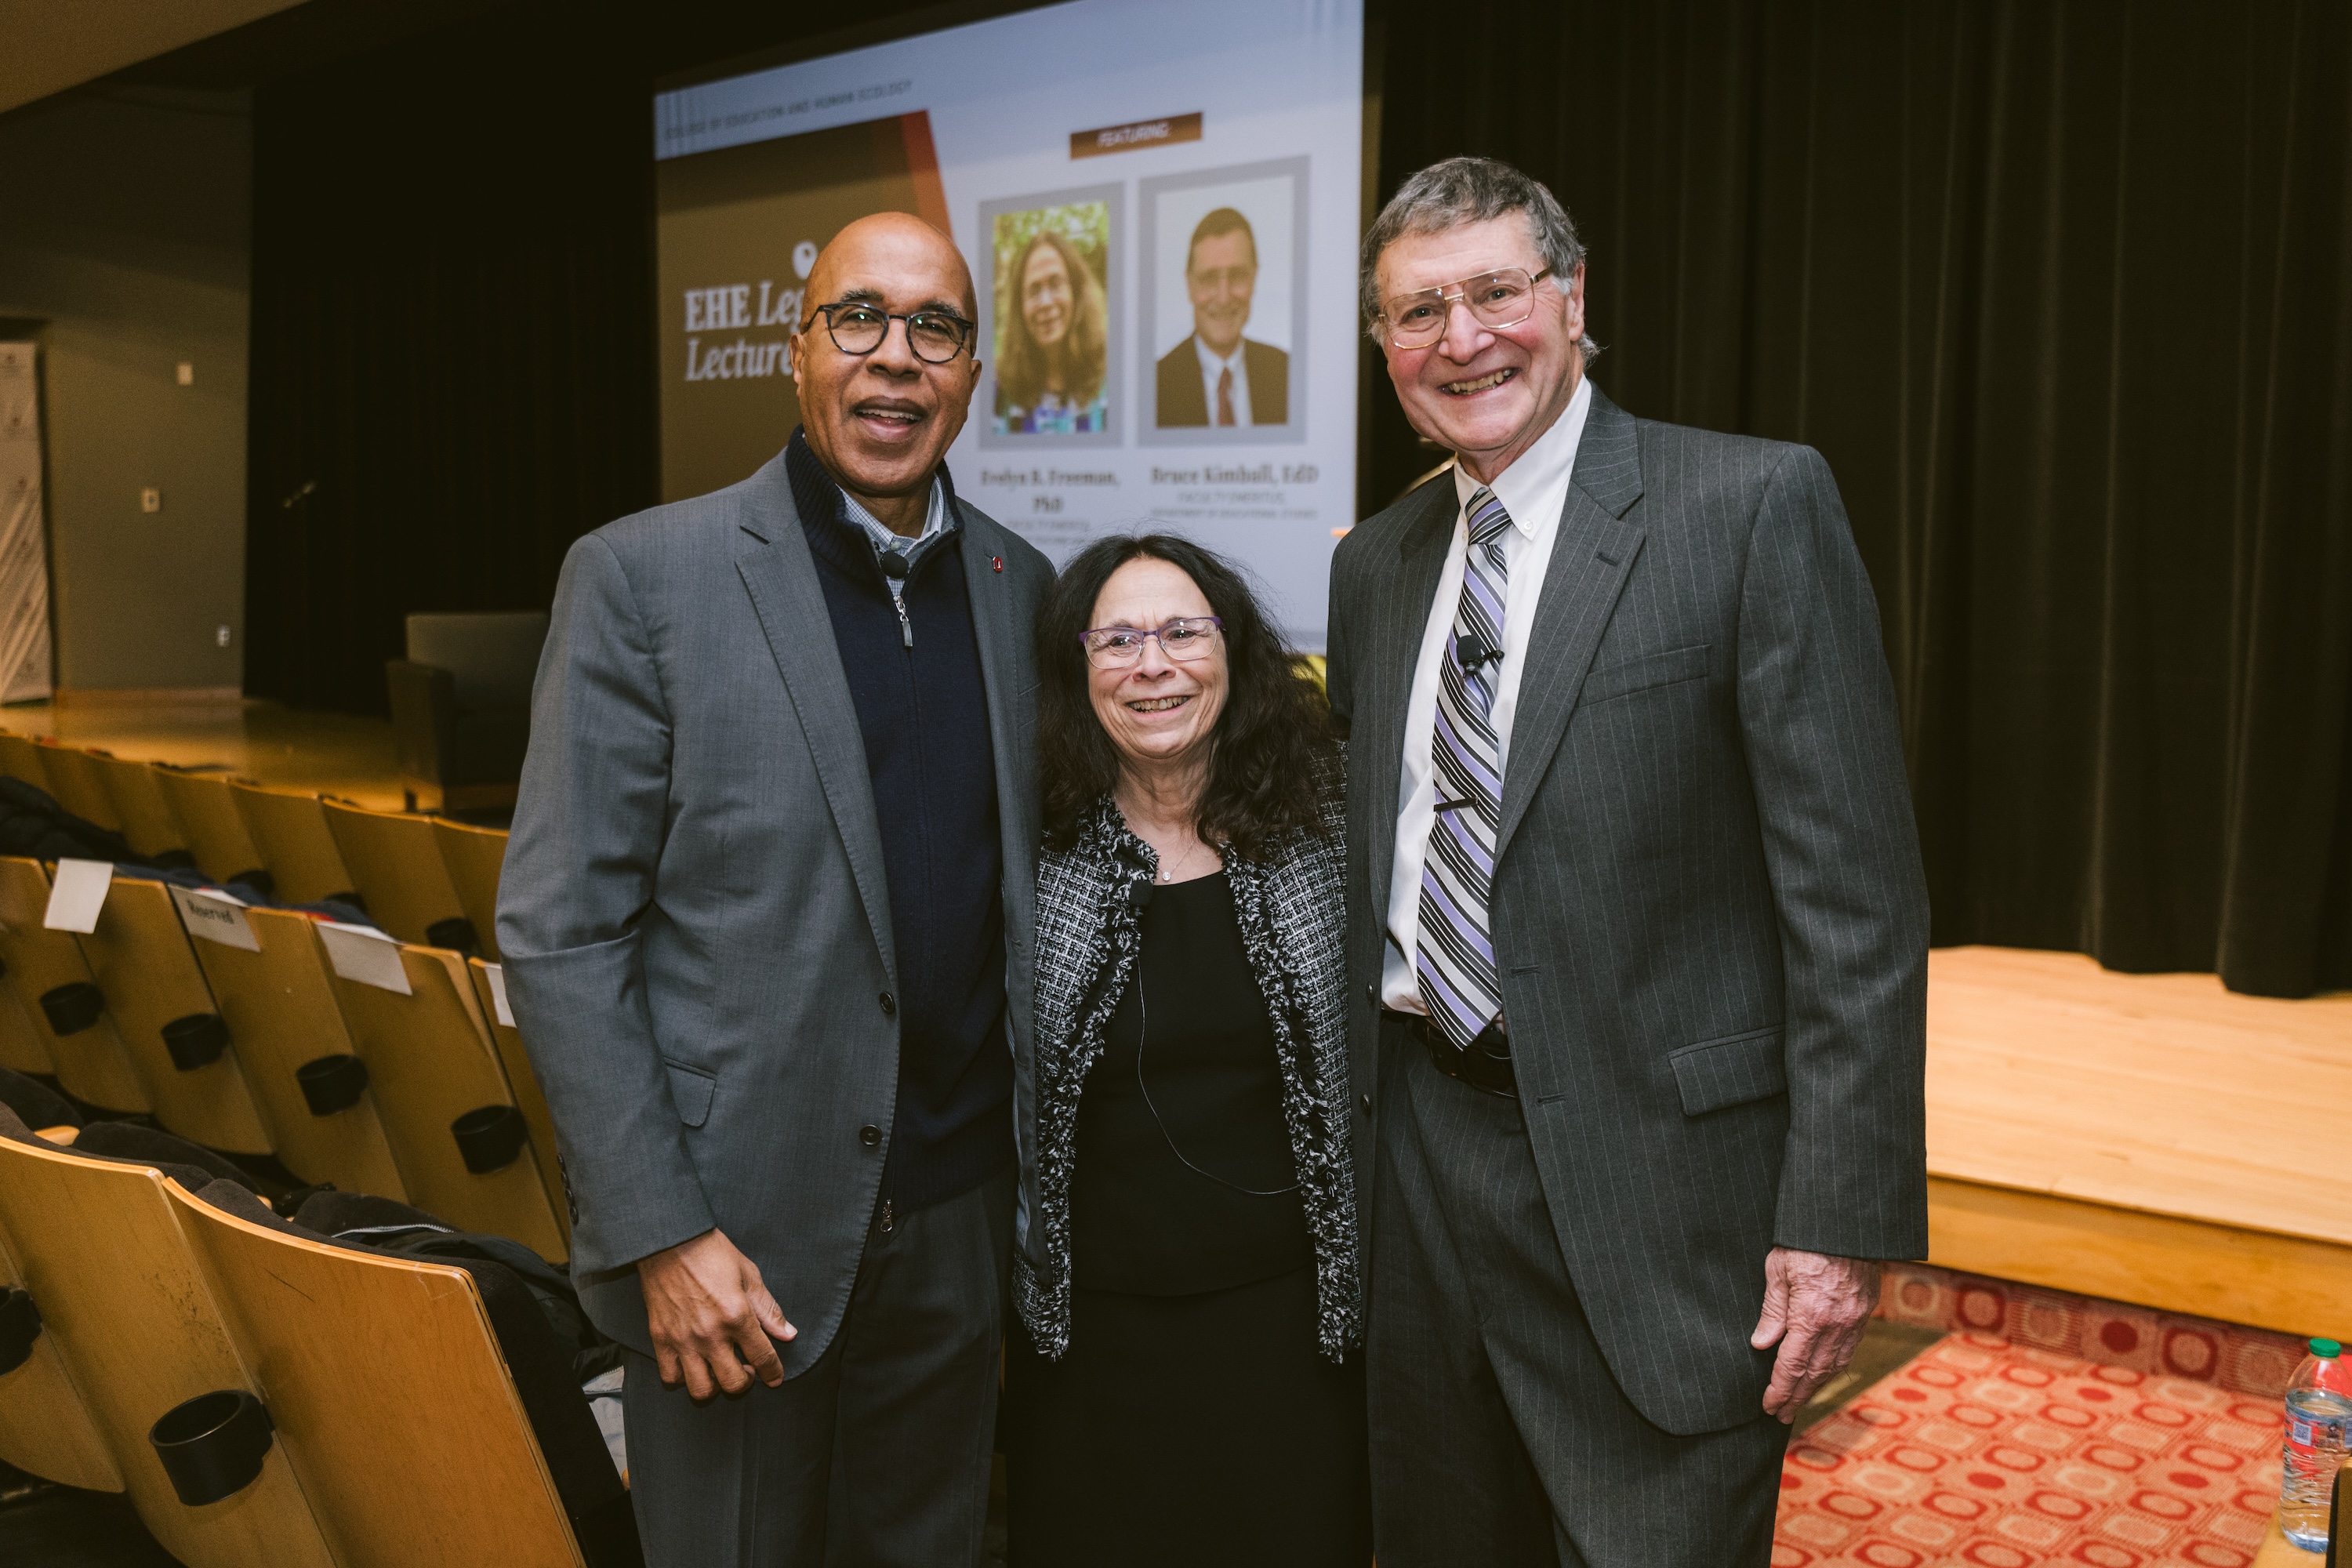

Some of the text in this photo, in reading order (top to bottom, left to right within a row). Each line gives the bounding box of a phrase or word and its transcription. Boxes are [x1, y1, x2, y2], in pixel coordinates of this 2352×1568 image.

[788, 100, 809, 114] AND
[815, 91, 855, 109] HUMAN
[858, 79, 913, 102] ECOLOGY
[1098, 123, 1169, 146] FEATURING
[684, 284, 750, 332] EHE
[982, 469, 1025, 491] Evelyn
[1049, 470, 1121, 489] Freeman,
[1152, 463, 1319, 486] Bruce Kimball, EdD
[1033, 495, 1064, 513] PhD
[186, 898, 234, 924] Reserved
